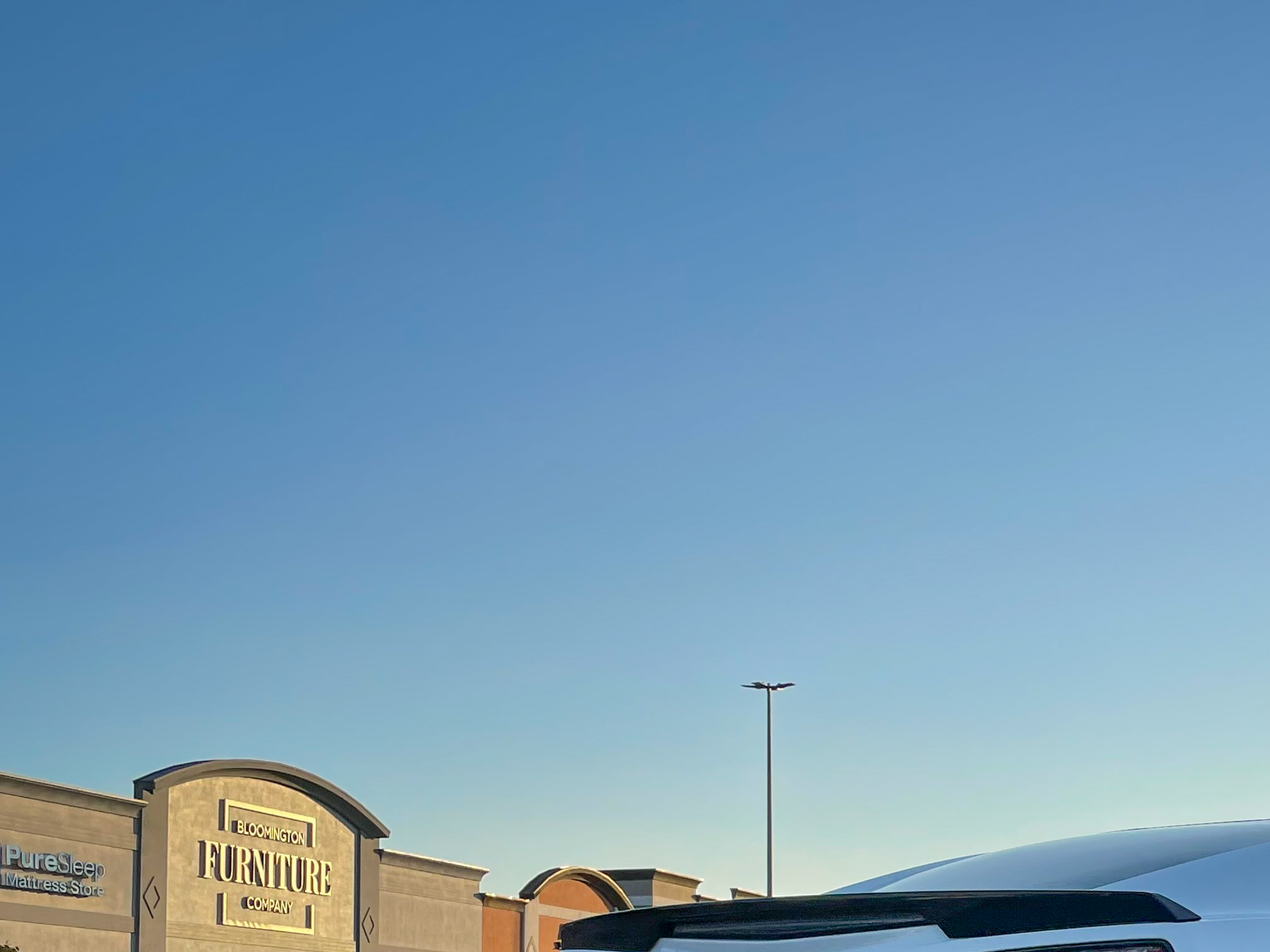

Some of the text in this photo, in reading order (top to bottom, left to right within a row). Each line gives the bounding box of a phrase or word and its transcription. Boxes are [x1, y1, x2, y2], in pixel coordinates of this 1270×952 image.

[237, 820, 305, 845] BLOOMINGTON
[6, 844, 106, 882] PureSleep
[203, 840, 333, 895] FURNITURE
[6, 872, 105, 897] Mattress Store
[247, 896, 294, 914] COMPANY
